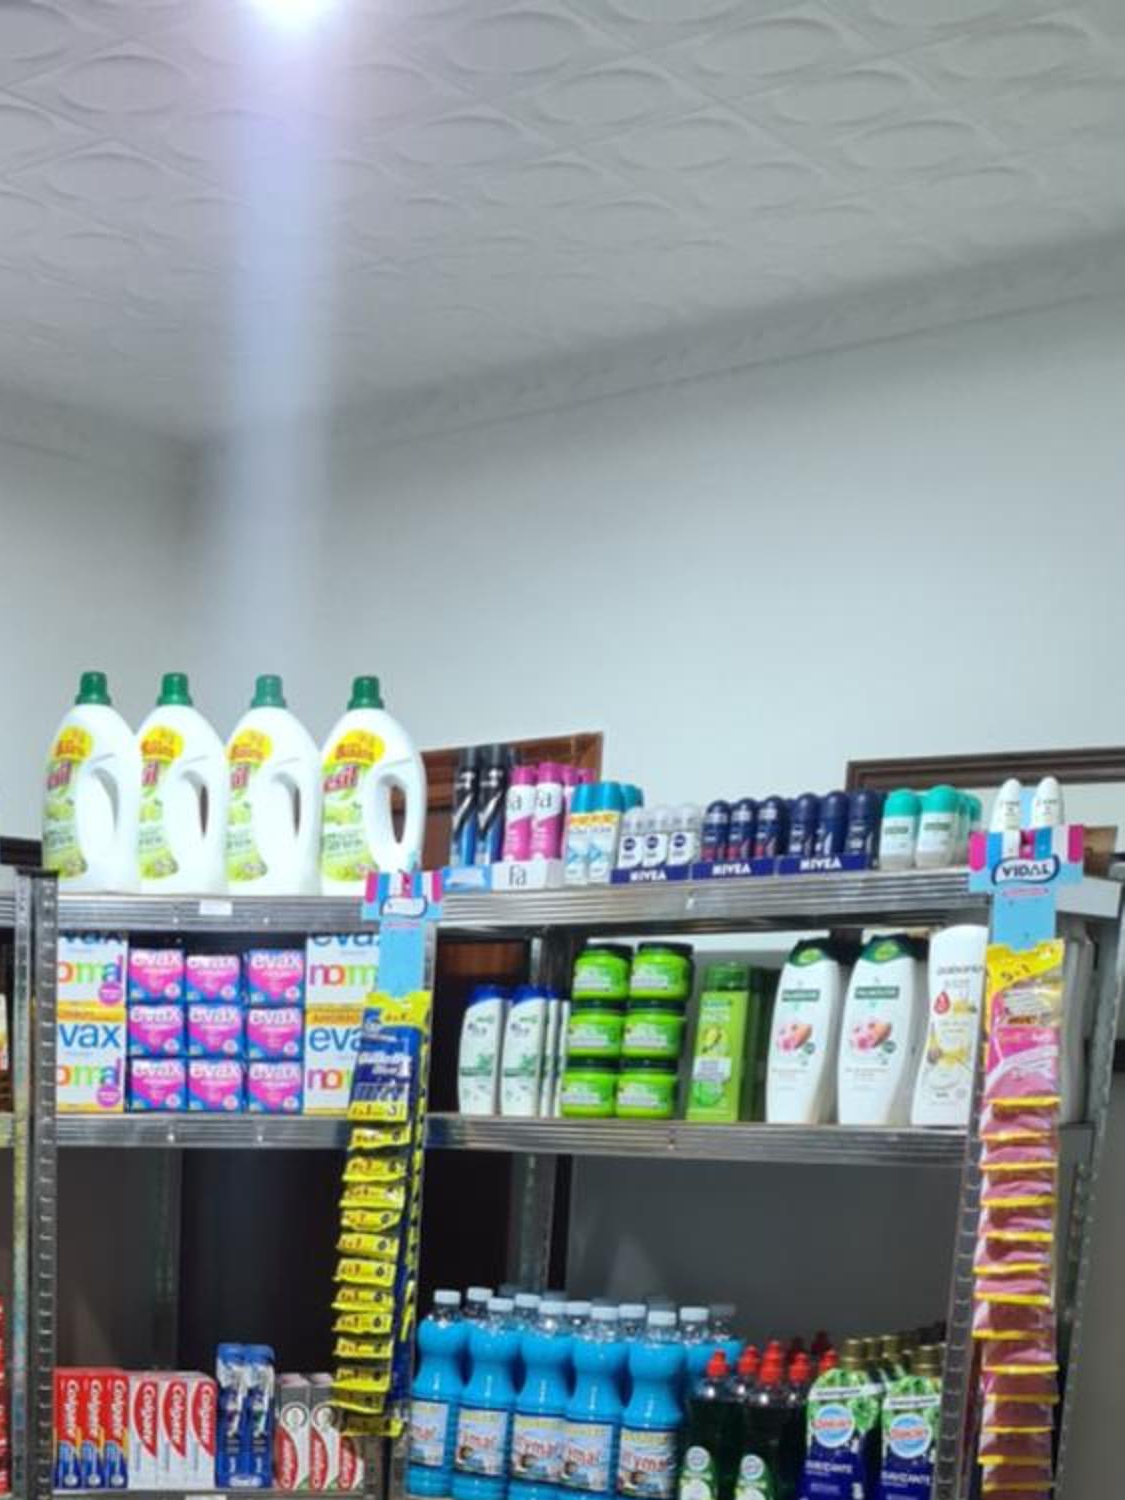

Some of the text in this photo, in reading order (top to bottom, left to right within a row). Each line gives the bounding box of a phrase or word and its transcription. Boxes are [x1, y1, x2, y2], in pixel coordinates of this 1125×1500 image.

[712, 861, 751, 876] NIVEA
[800, 855, 842, 871] NIVEA
[630, 867, 667, 882] NIVEA
[1002, 863, 1052, 879] VIDAL
